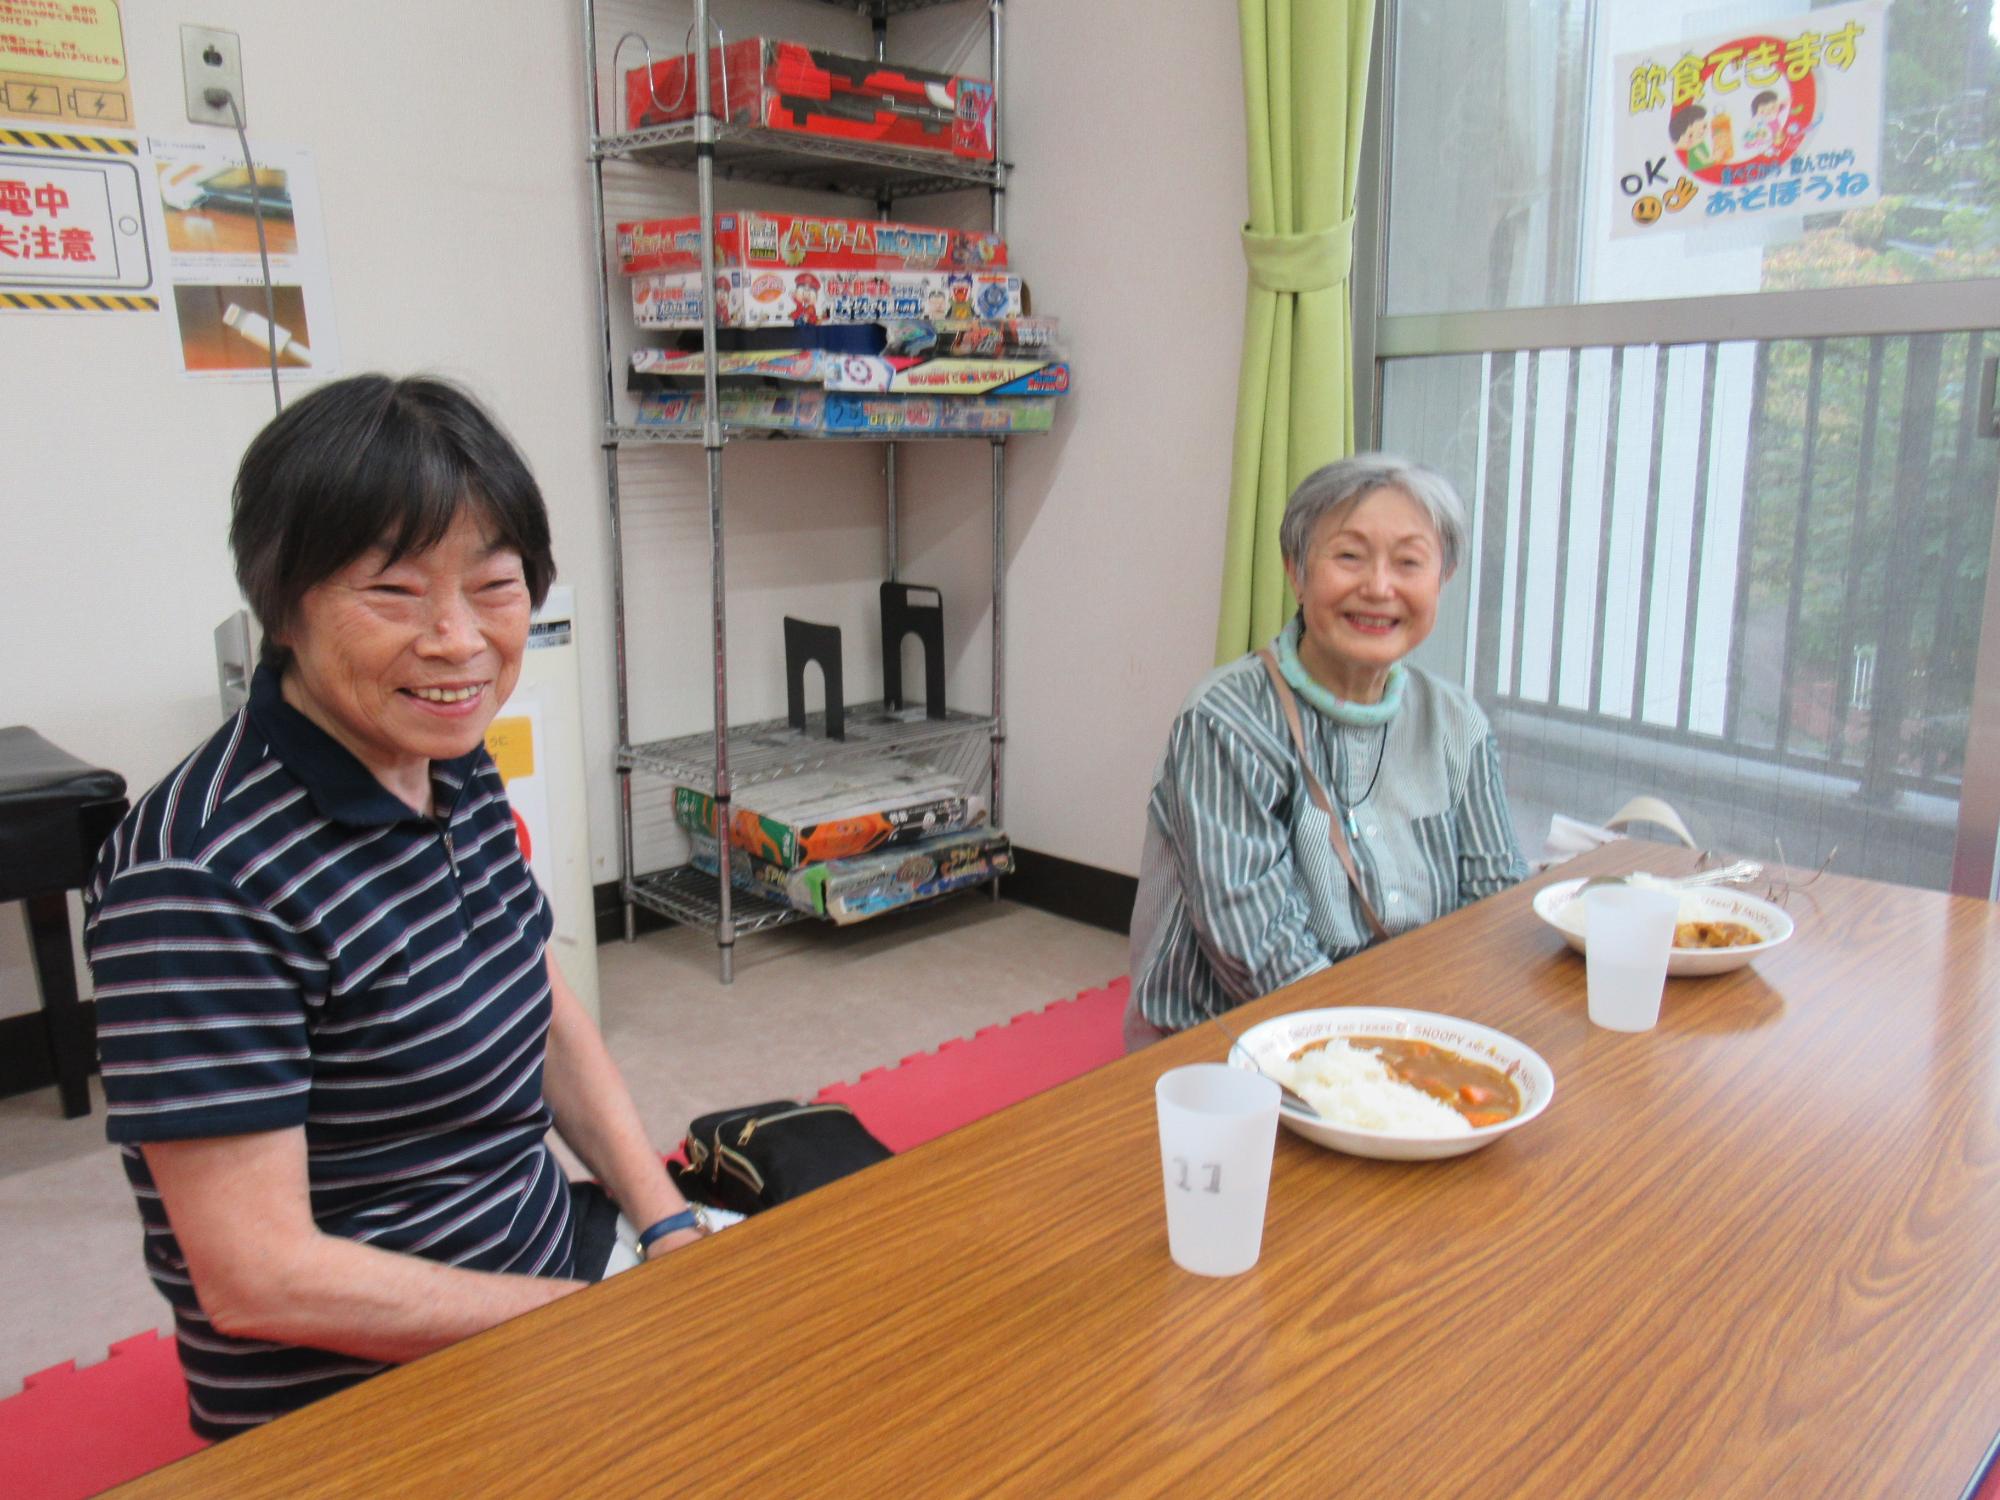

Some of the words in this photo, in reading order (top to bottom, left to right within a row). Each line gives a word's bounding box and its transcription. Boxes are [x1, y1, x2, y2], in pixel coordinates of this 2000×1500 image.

[1629, 19, 1866, 114] 飲食できます
[1620, 156, 1669, 197] OK
[1705, 170, 1871, 217] あそぼうね
